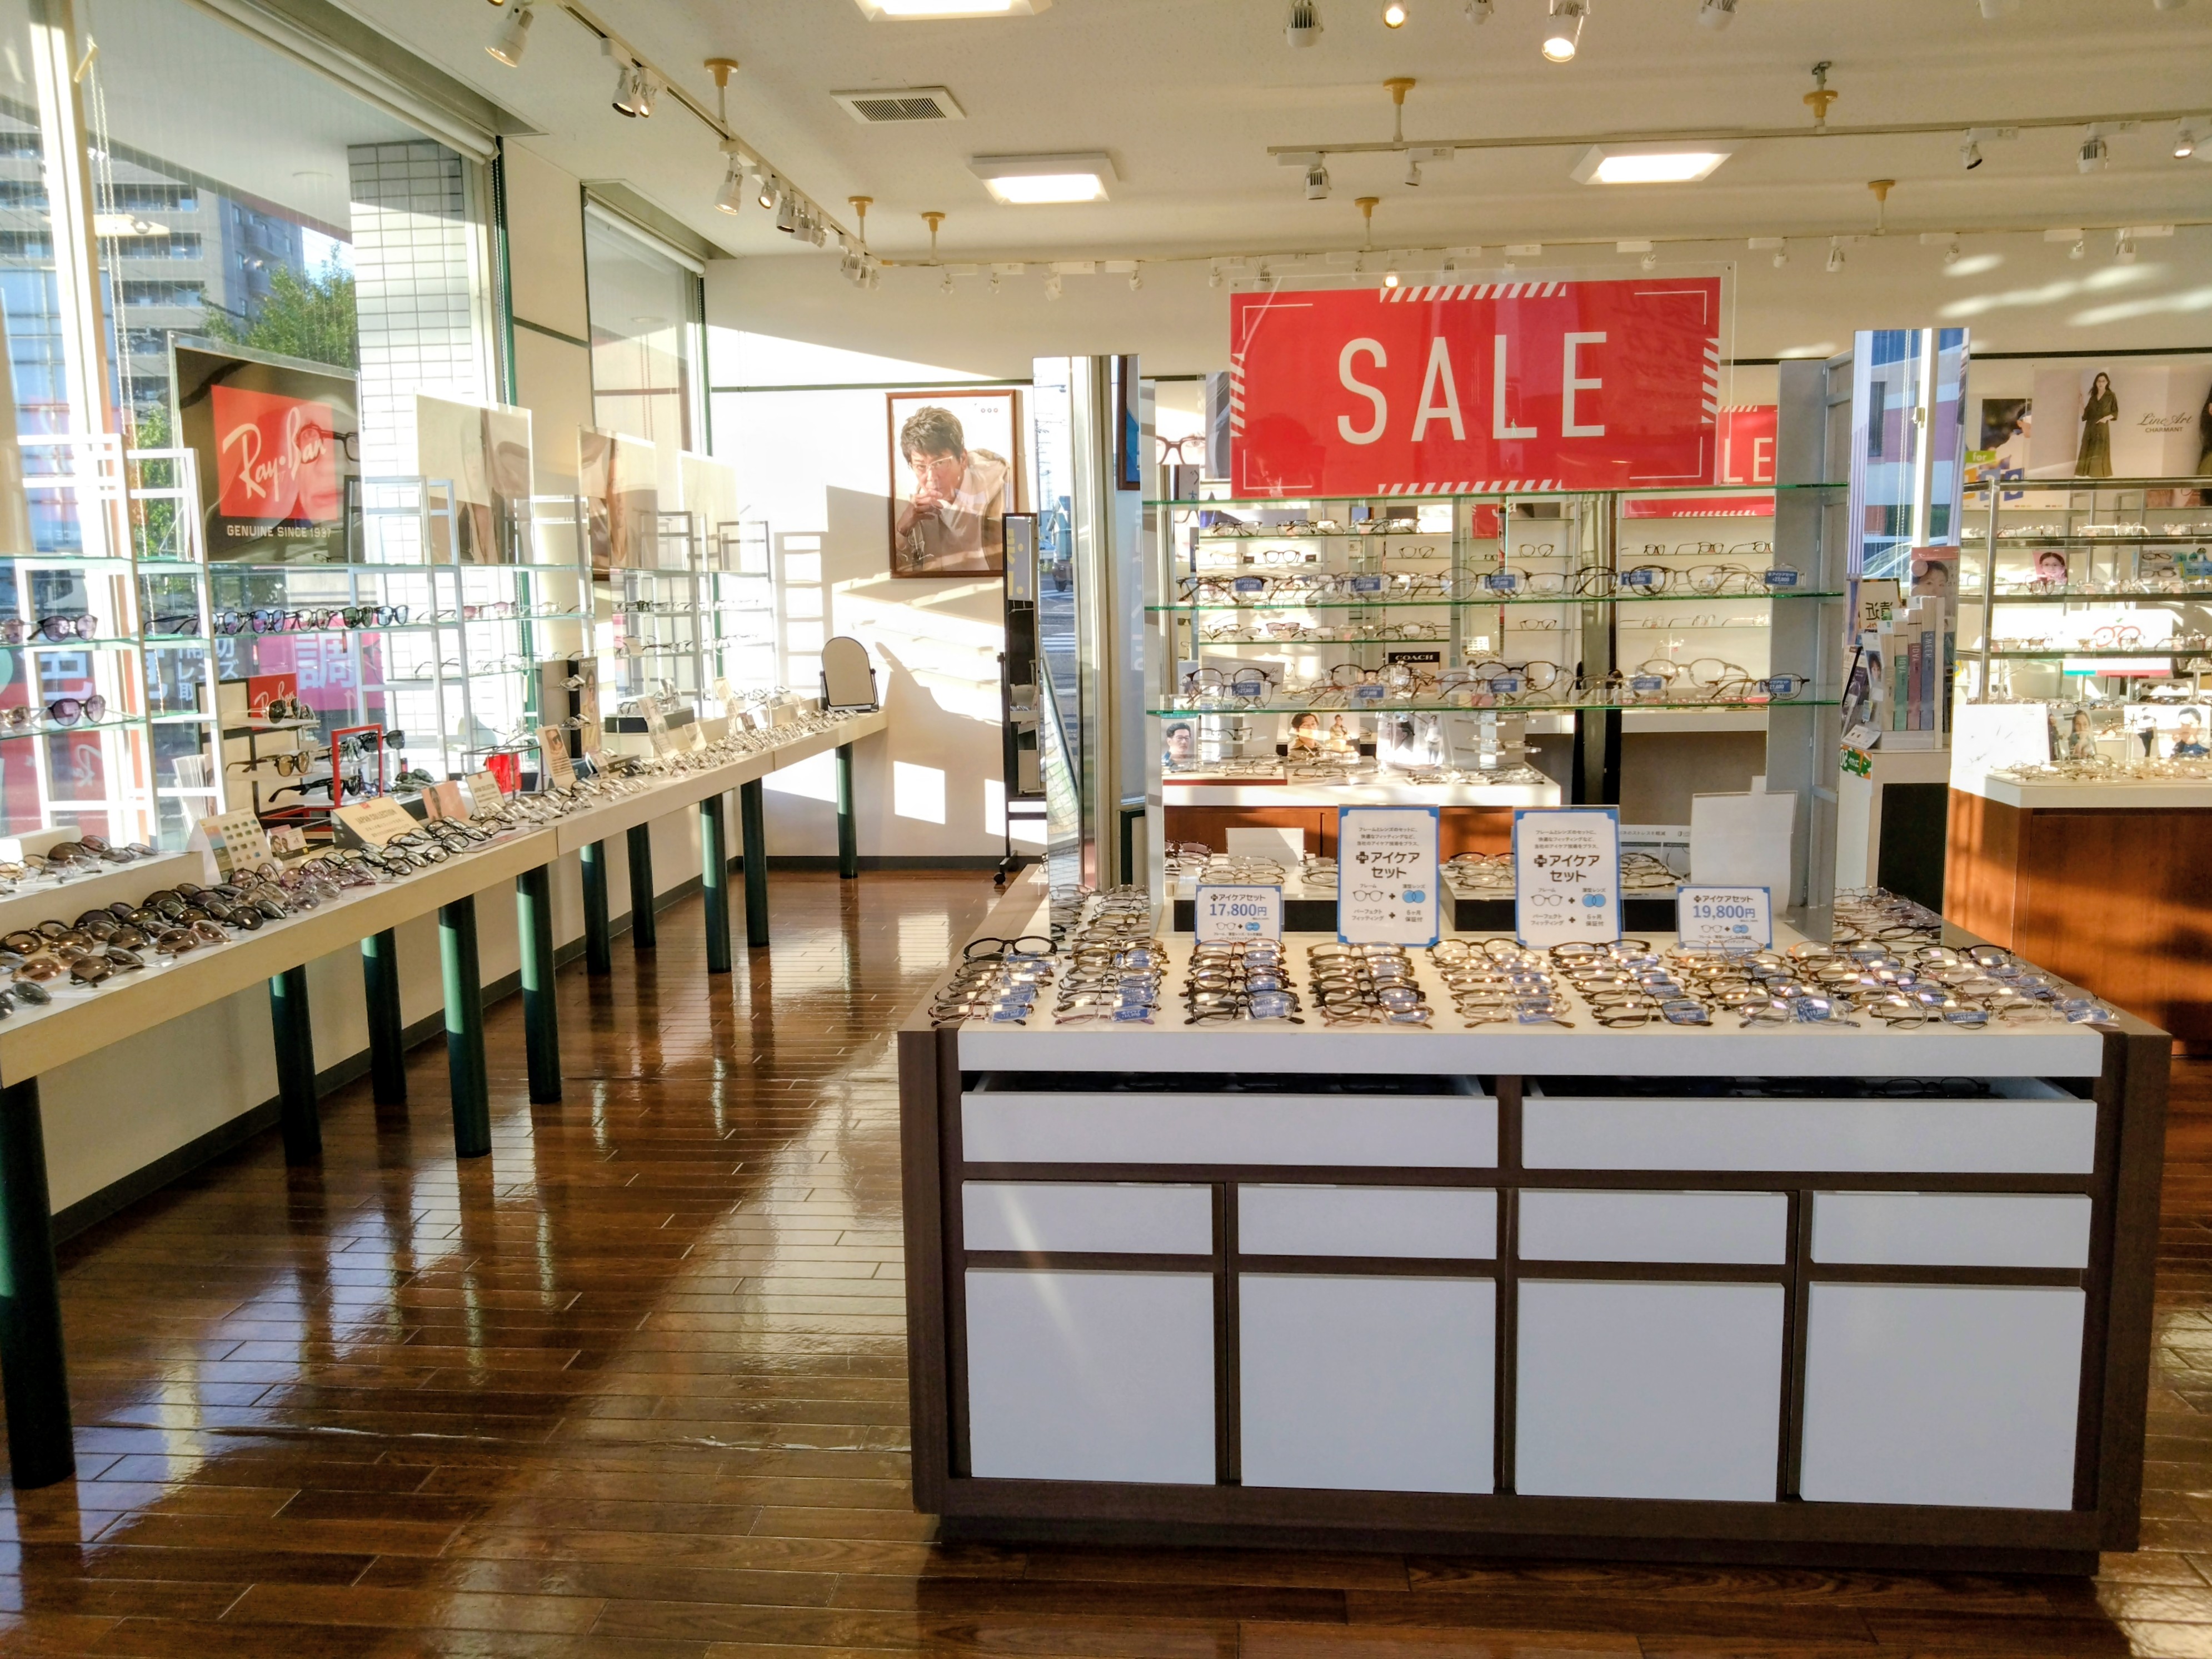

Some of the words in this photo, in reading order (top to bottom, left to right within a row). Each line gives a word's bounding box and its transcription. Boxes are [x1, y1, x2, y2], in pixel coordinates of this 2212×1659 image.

[1337, 332, 1607, 444] SALE
[2136, 413, 2167, 426] Line
[2164, 412, 2193, 426] Art
[1724, 437, 1773, 482] LE
[1973, 452, 1987, 461] for
[227, 525, 273, 537] GENUINE
[277, 527, 307, 538] SINCE
[309, 527, 332, 538] 1937
[1371, 852, 1420, 863] アイケア
[1549, 855, 1600, 867] アイケア
[1371, 867, 1407, 879] セット
[1550, 870, 1586, 882] セット
[1210, 903, 1267, 916] 17,800円
[1693, 905, 1755, 920] 19,800円
